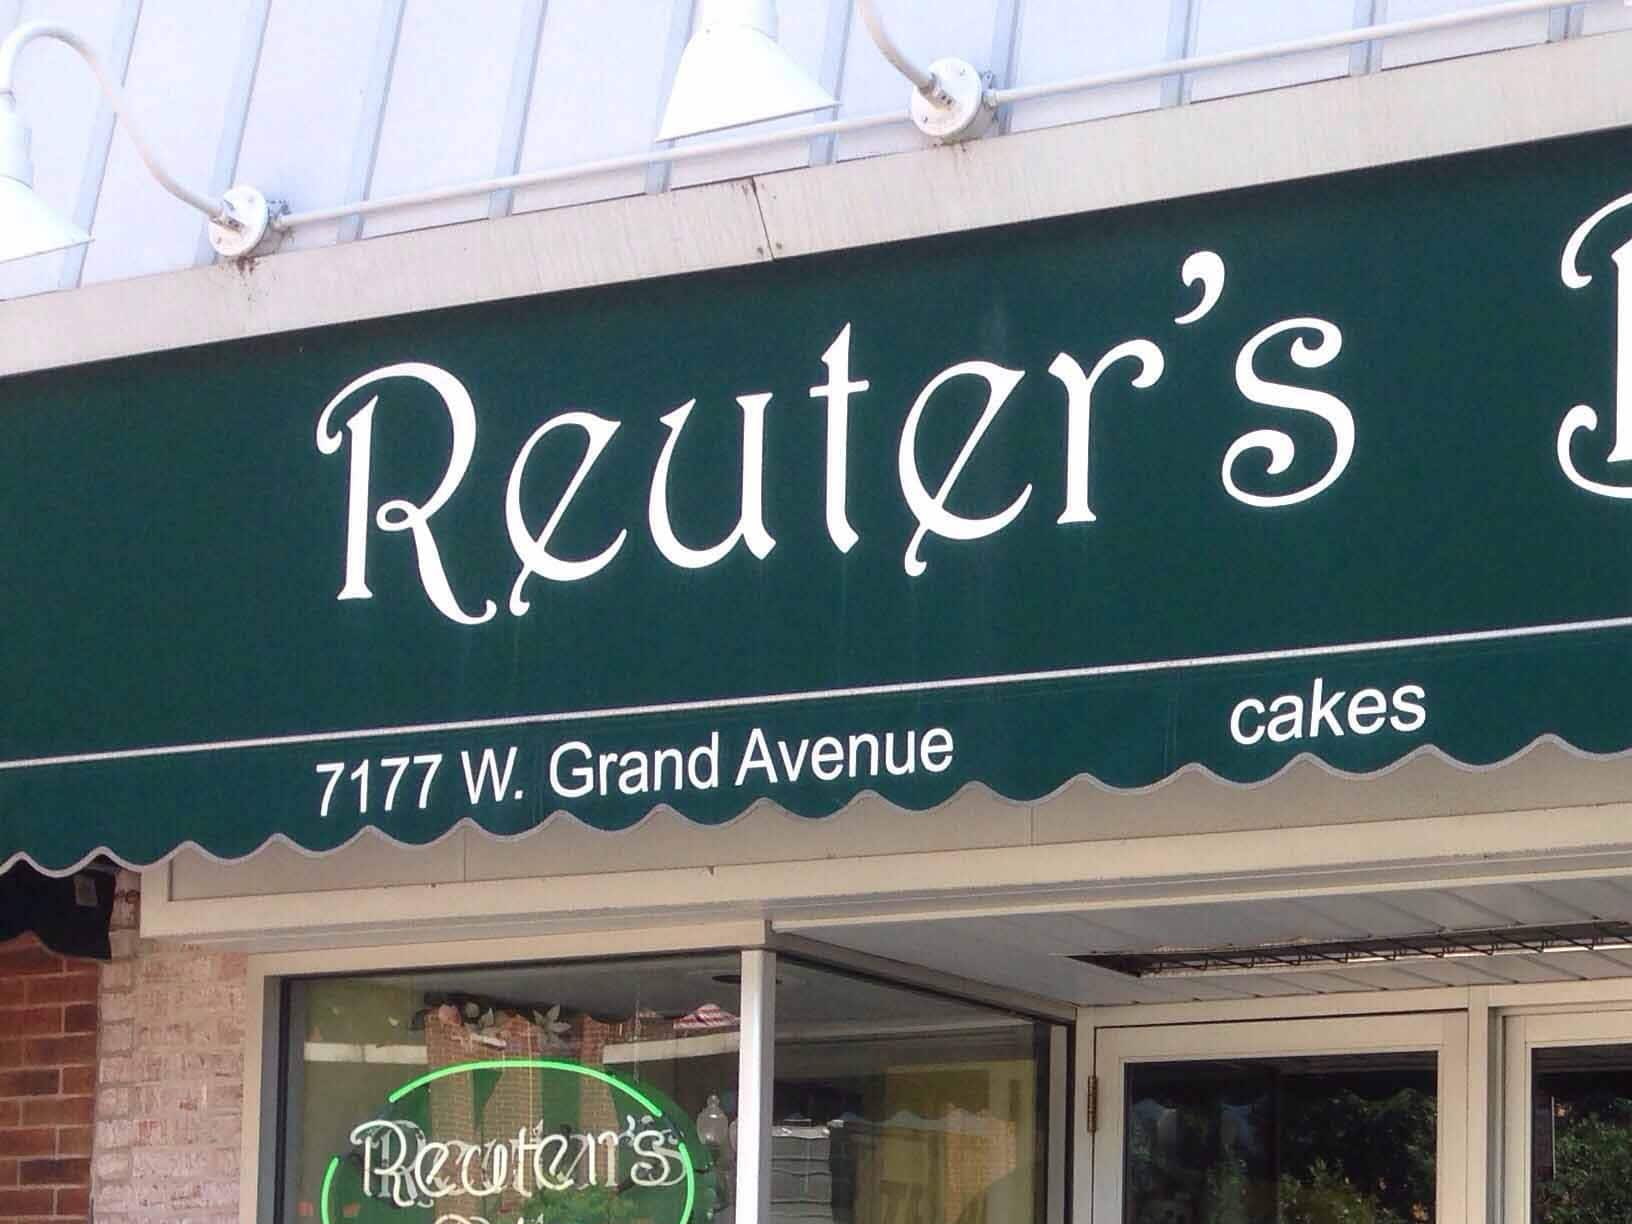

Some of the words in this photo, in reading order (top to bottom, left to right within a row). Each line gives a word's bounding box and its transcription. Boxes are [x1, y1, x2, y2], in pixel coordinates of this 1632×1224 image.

[316, 251, 1356, 625] Reuter's
[1230, 677, 1427, 745] cakes
[315, 753, 444, 817] 7177
[460, 746, 524, 805] W.
[549, 731, 719, 798] Grand
[734, 727, 955, 786] Avenue
[351, 1114, 678, 1207] Reuter's
